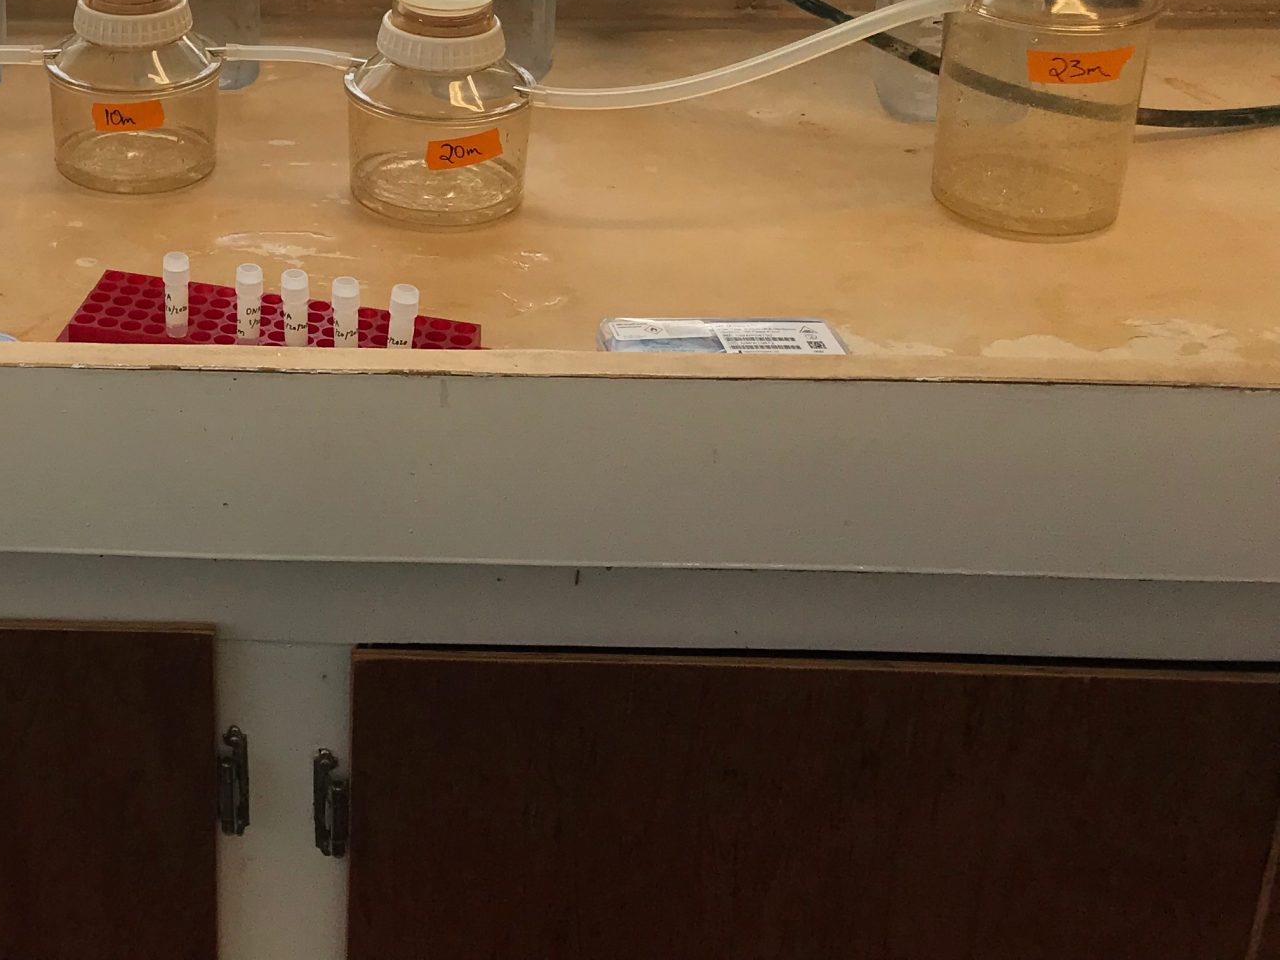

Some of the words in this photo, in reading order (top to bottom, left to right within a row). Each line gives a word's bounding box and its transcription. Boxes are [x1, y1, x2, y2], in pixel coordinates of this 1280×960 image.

[1048, 58, 1111, 82] 23m
[104, 108, 136, 126] 10m
[439, 143, 483, 164] 20m
